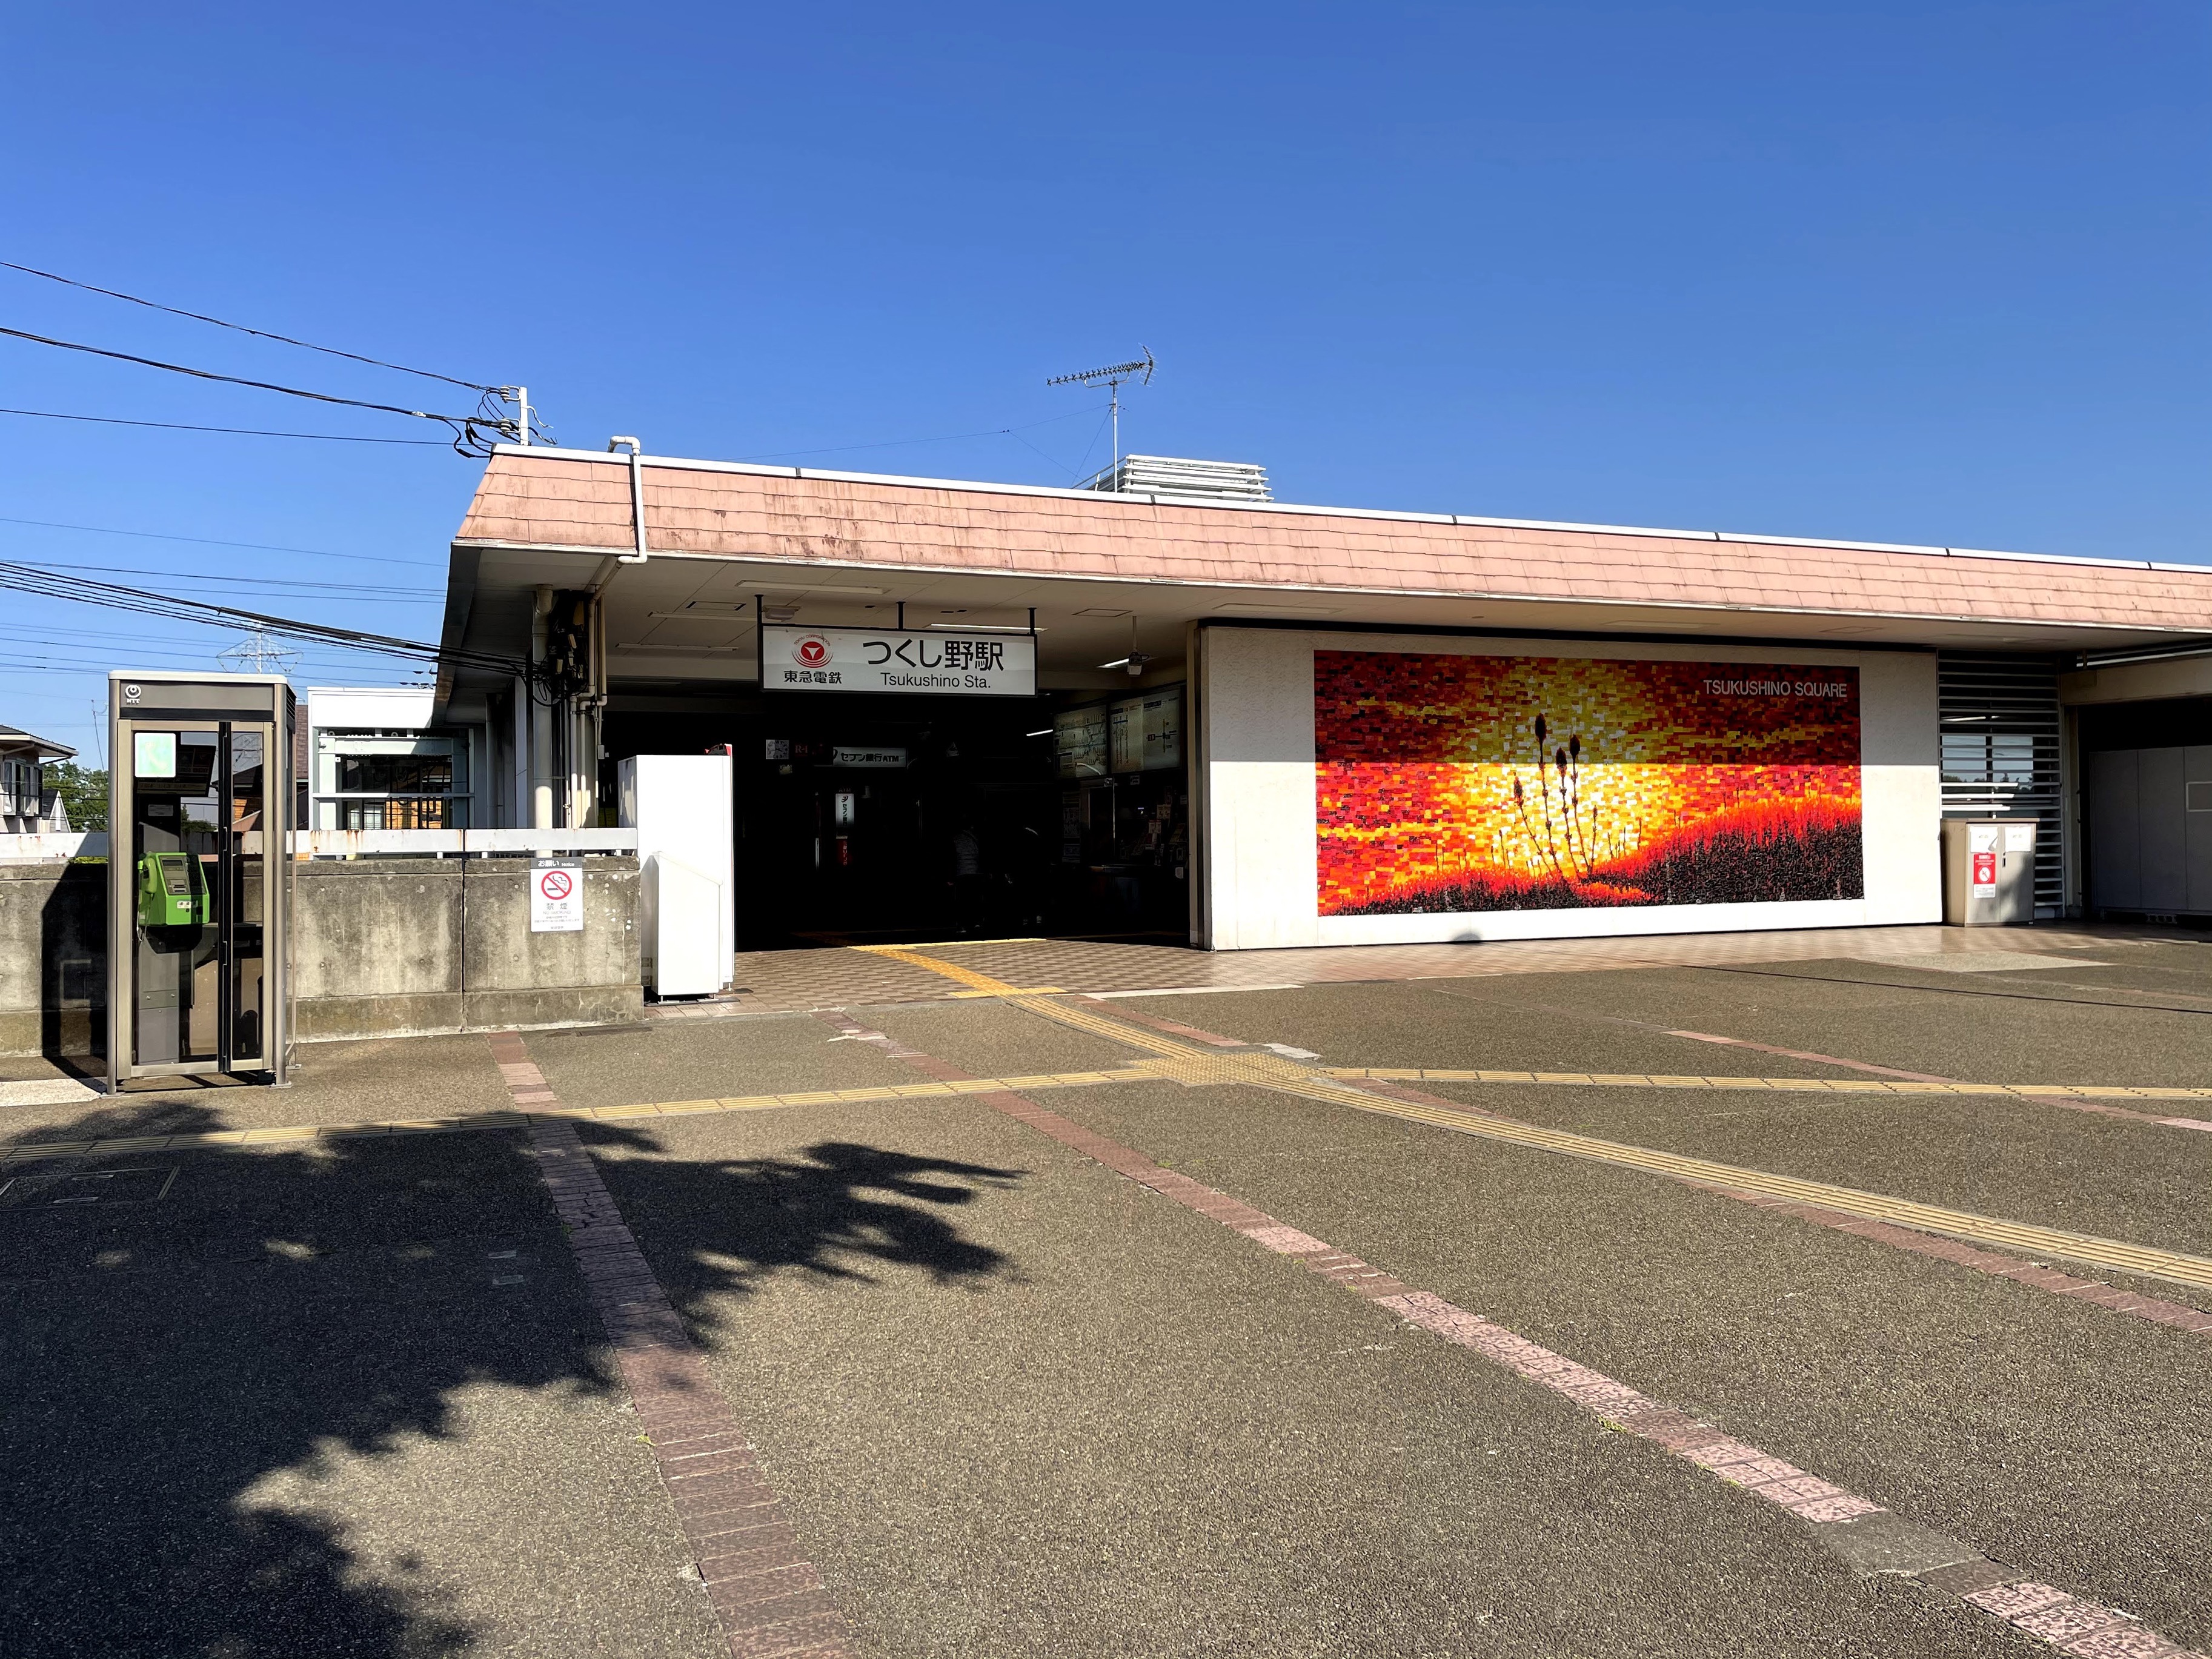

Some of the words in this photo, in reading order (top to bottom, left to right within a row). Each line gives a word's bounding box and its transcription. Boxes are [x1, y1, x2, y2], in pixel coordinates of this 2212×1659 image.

[863, 638, 1004, 671] つくし野駅
[783, 670, 842, 684] 東急電鉄
[880, 672, 960, 687] Tsukushino
[965, 674, 991, 688] Sta.
[1703, 679, 1790, 696] TSUKUSHINO
[1795, 681, 1847, 697] SQUARE
